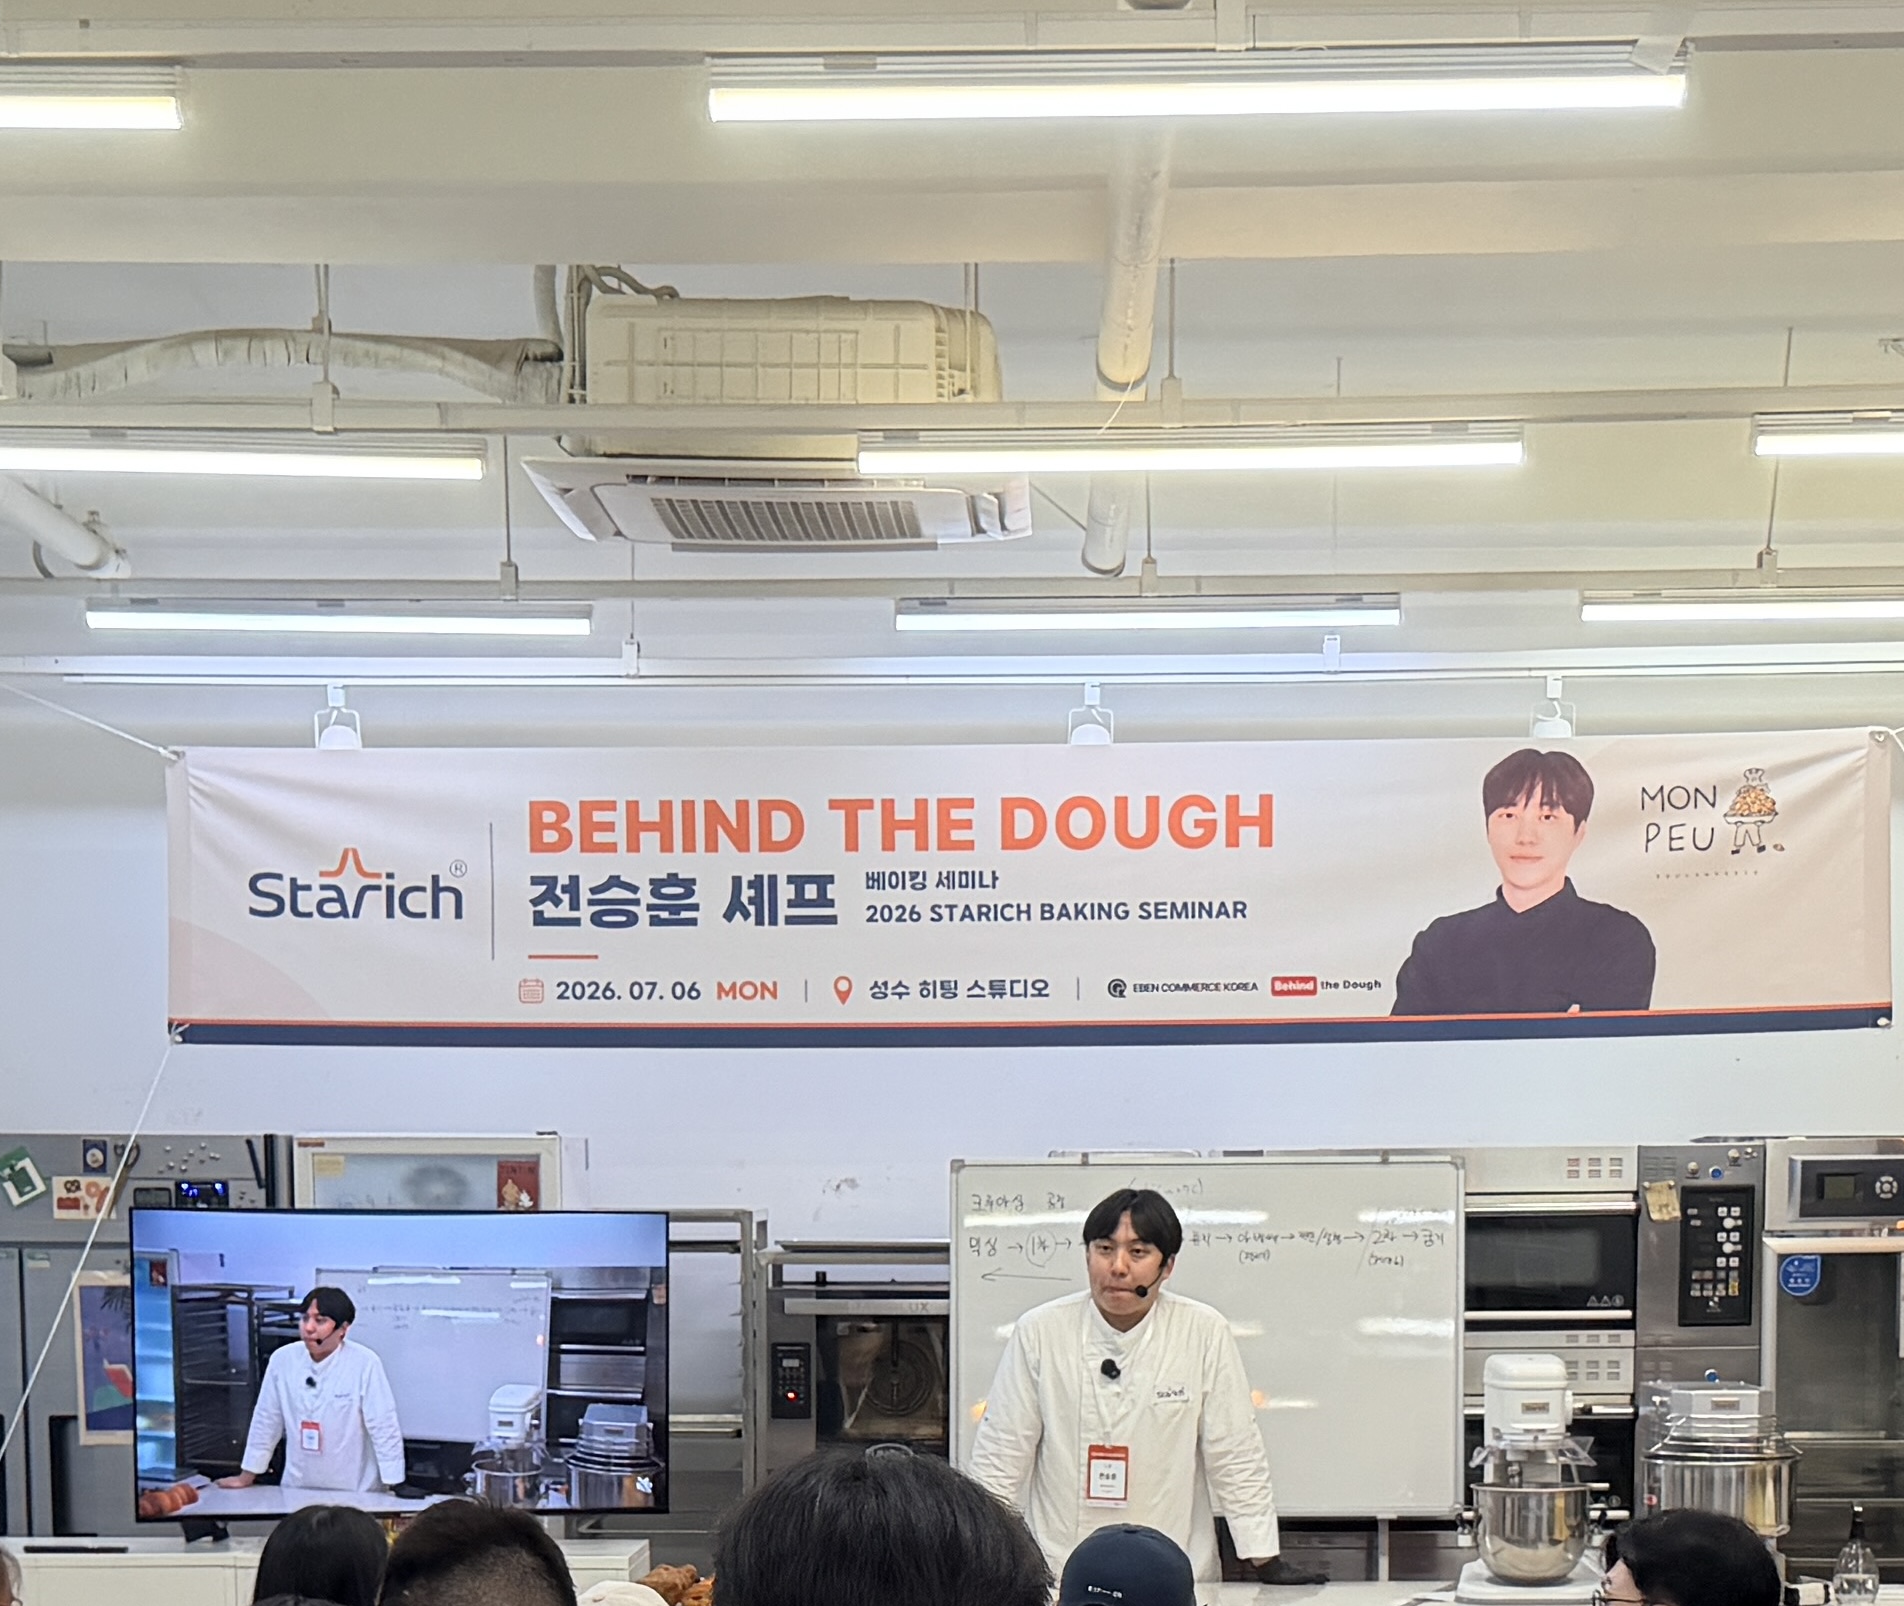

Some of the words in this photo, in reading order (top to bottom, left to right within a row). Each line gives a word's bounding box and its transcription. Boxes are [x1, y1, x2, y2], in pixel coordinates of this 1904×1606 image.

[1641, 785, 1716, 813] MON
[528, 799, 805, 854] BEHIND
[828, 797, 976, 852] THE
[1000, 794, 1274, 851] DOUGH
[1645, 822, 1715, 853] PEU
[865, 870, 928, 891] 베이킹
[935, 869, 1000, 891] 세미나
[248, 872, 463, 919] Starich
[529, 872, 700, 929] 전승훈
[722, 873, 838, 927] 셰프
[866, 904, 922, 924] 2026
[929, 903, 1033, 923] STARICH
[1040, 902, 1130, 922] BAKING
[1137, 900, 1248, 920] SEMINAR
[556, 981, 622, 1001] 2026.
[629, 981, 664, 1001] 07.
[670, 981, 702, 1000] 06
[716, 980, 778, 1001] MON
[868, 979, 910, 1000] 성수
[919, 979, 959, 1000] 히팅
[966, 978, 1050, 1000] 스튜디오
[1162, 982, 1222, 993] COMMERCE
[1223, 982, 1259, 992] KOREA
[1274, 980, 1314, 991] Behind
[1320, 980, 1340, 990] the
[1342, 979, 1382, 991] Dough
